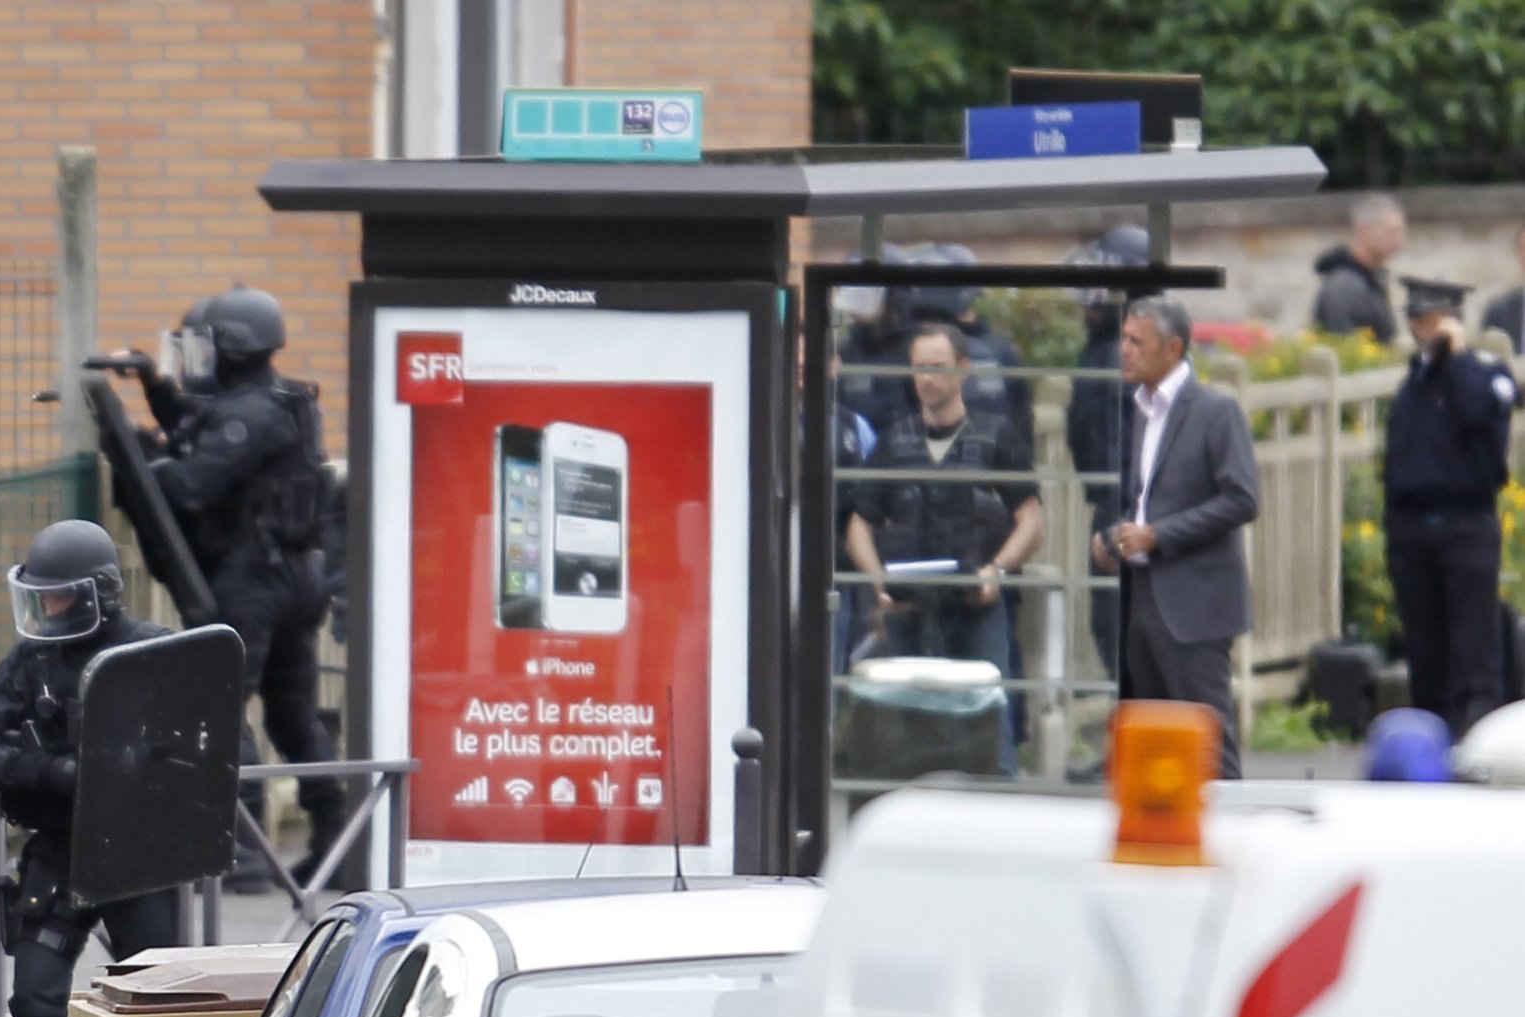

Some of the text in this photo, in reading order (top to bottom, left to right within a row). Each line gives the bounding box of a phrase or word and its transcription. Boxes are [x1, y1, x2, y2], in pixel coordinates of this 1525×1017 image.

[625, 103, 652, 118] 132
[509, 284, 596, 304] JCDecaux
[409, 352, 463, 380] SFR
[542, 658, 595, 676] iPhone
[465, 697, 654, 725] Avec le réseau
[455, 727, 663, 760] le plus complet.
